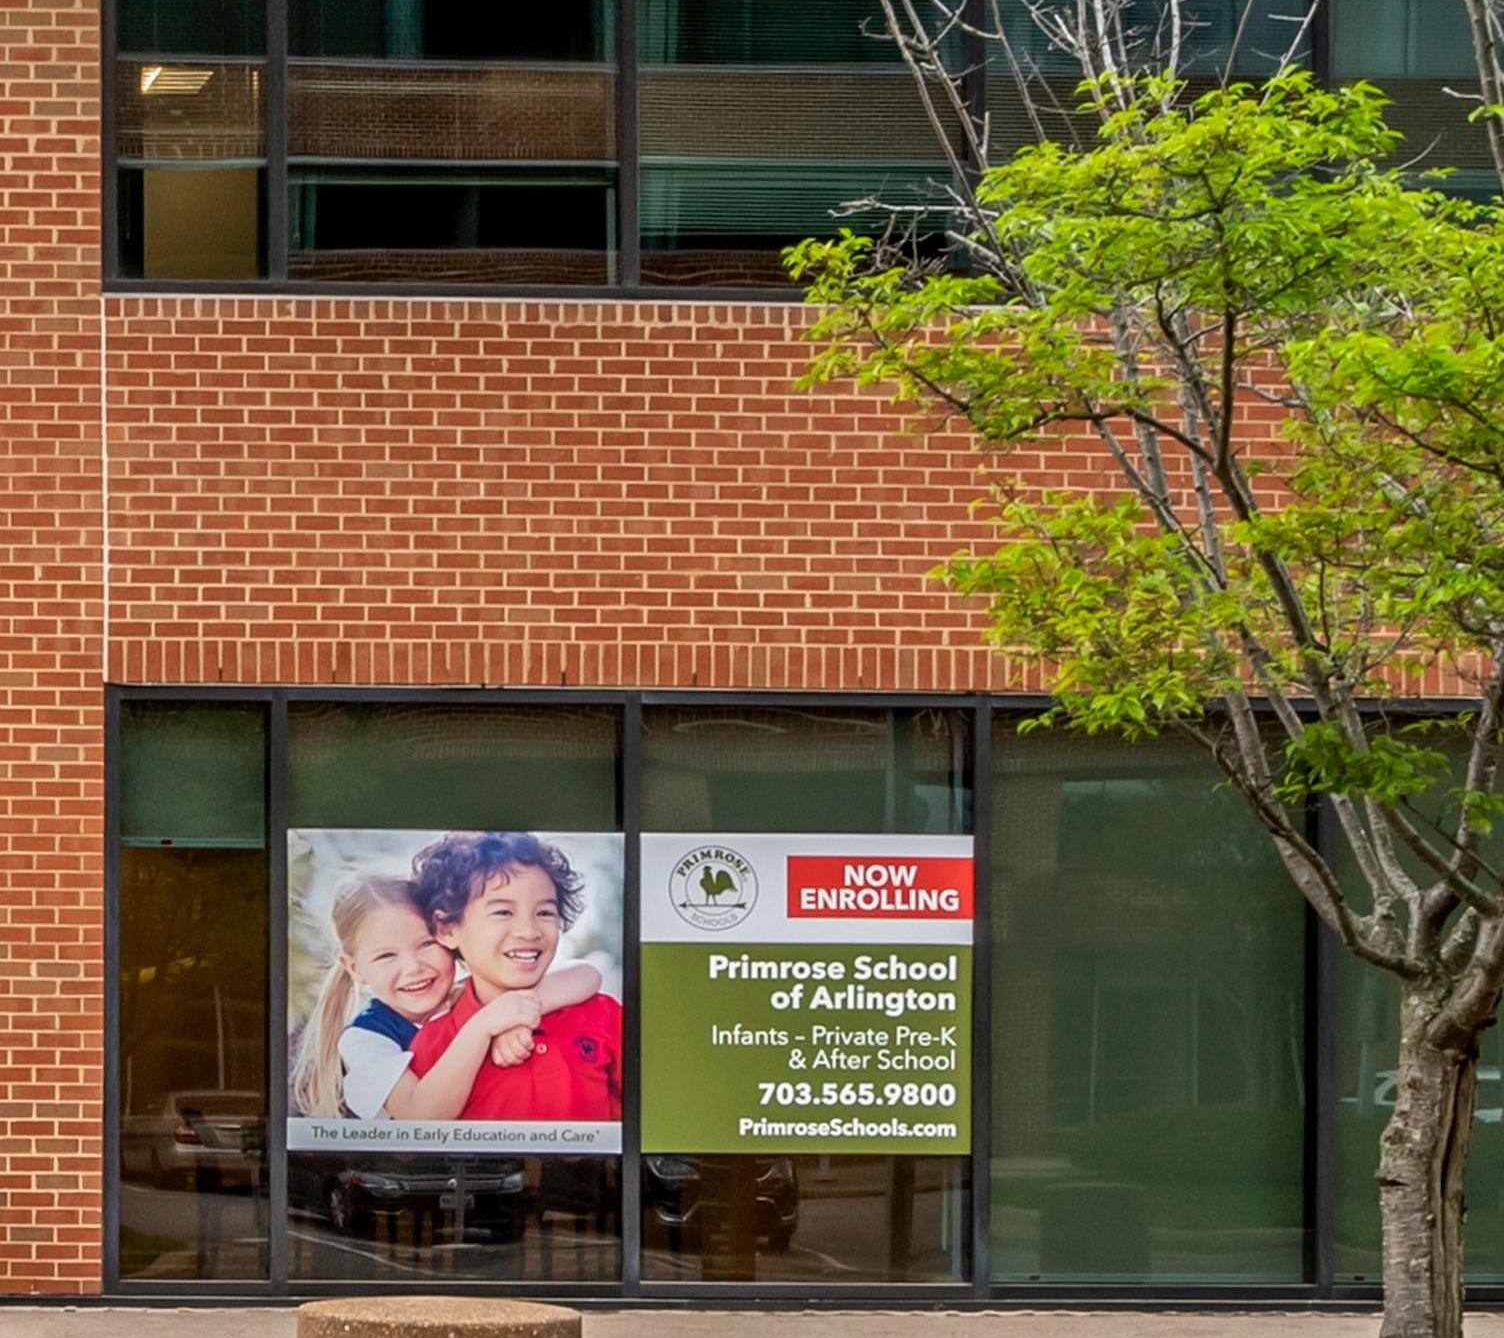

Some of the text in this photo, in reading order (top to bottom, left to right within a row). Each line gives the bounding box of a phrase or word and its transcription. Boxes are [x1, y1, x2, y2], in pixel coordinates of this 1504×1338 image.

[677, 850, 749, 877] PRIMROSE
[844, 865, 917, 887] NOW
[800, 888, 960, 912] ENROLLING
[690, 913, 739, 927] SCHOOLS
[709, 954, 958, 981] Primrose School
[770, 984, 957, 1017] of Arlington
[712, 1024, 789, 1046] Infants
[812, 1025, 889, 1047] Private
[896, 1027, 957, 1047] Pre-K
[788, 1048, 956, 1071] & After School
[758, 1082, 956, 1107] 703.565.9800
[311, 1126, 338, 1139] The
[343, 1126, 392, 1140] Leader
[396, 1127, 409, 1139] in
[414, 1126, 449, 1143] Early
[453, 1127, 526, 1141] Education
[530, 1128, 557, 1141] and
[739, 1118, 957, 1138] PrimroseSchools.com
